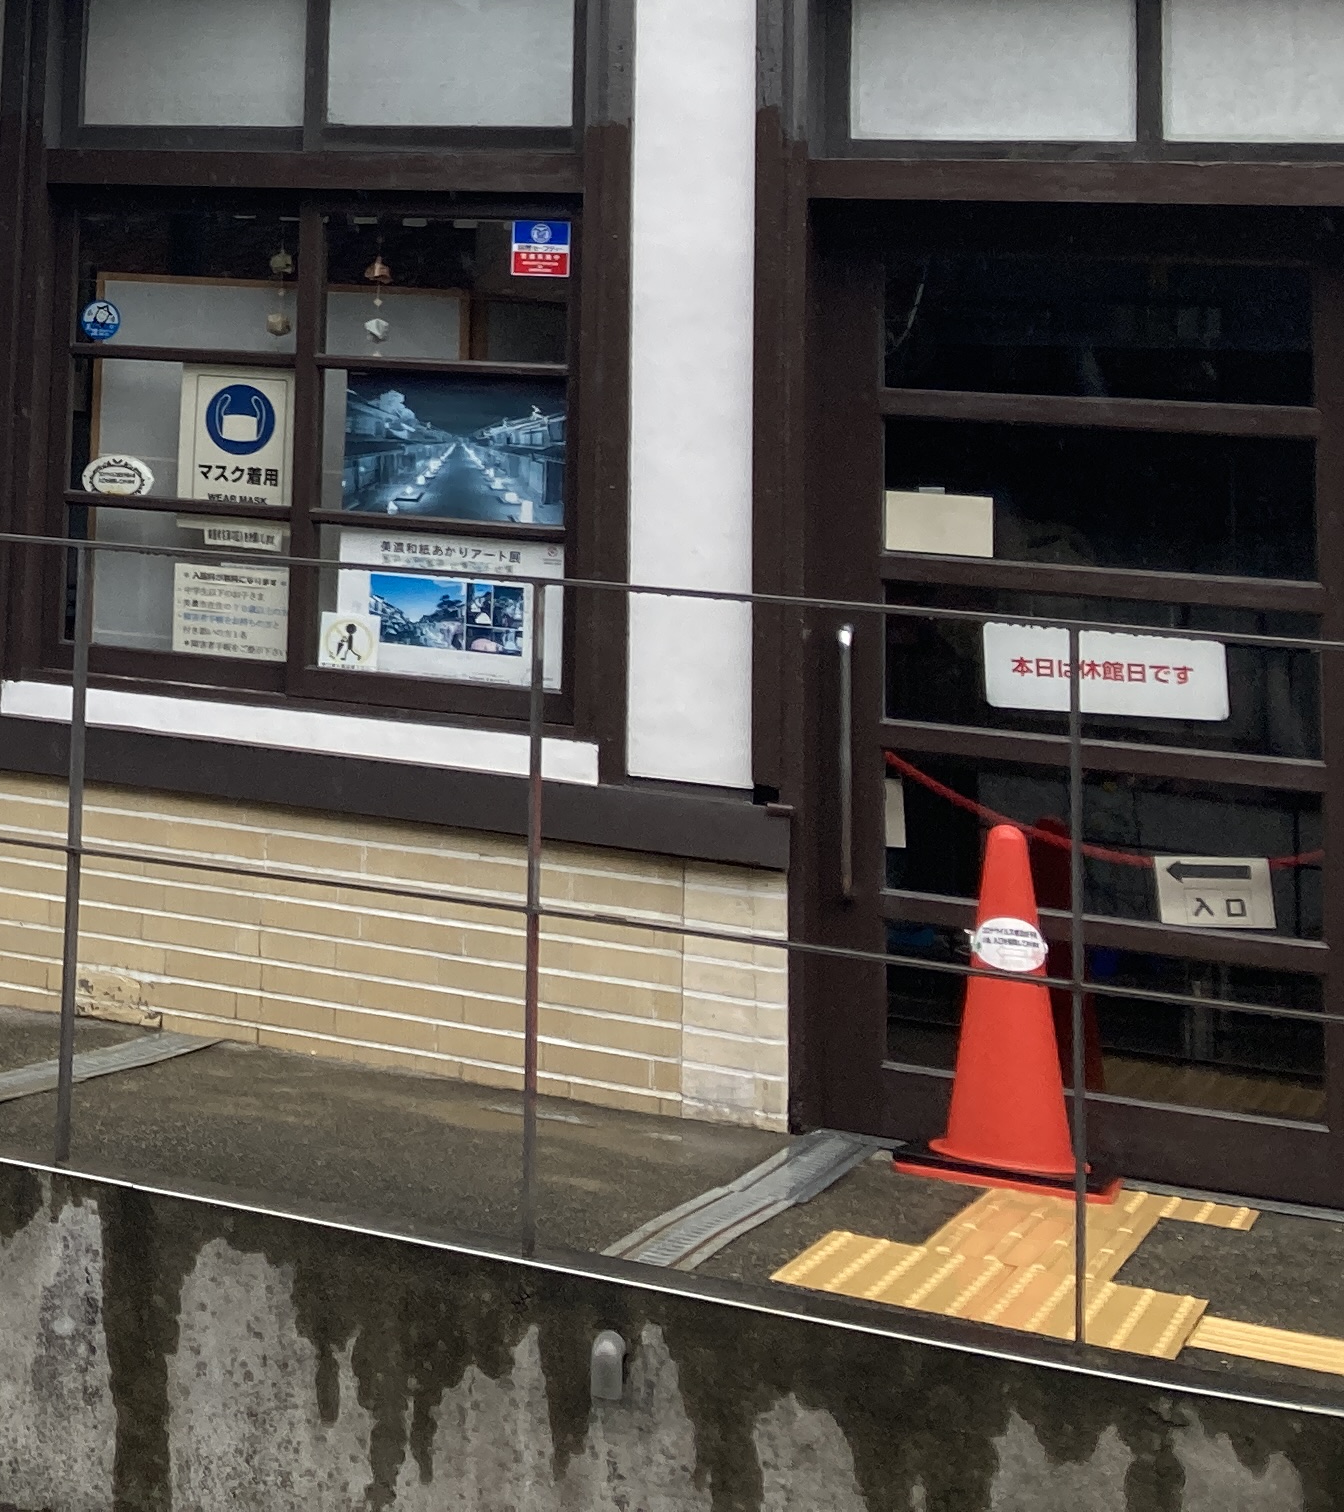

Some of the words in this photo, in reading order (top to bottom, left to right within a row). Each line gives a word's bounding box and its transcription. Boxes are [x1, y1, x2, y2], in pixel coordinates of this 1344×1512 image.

[198, 464, 279, 487] マスク着用
[207, 493, 238, 504] WEAR
[239, 495, 268, 506] MASK
[380, 540, 522, 564] 美濃和紙あかりアート展
[1011, 656, 1194, 685] 本日は休館日です
[1193, 897, 1247, 918] 入口
